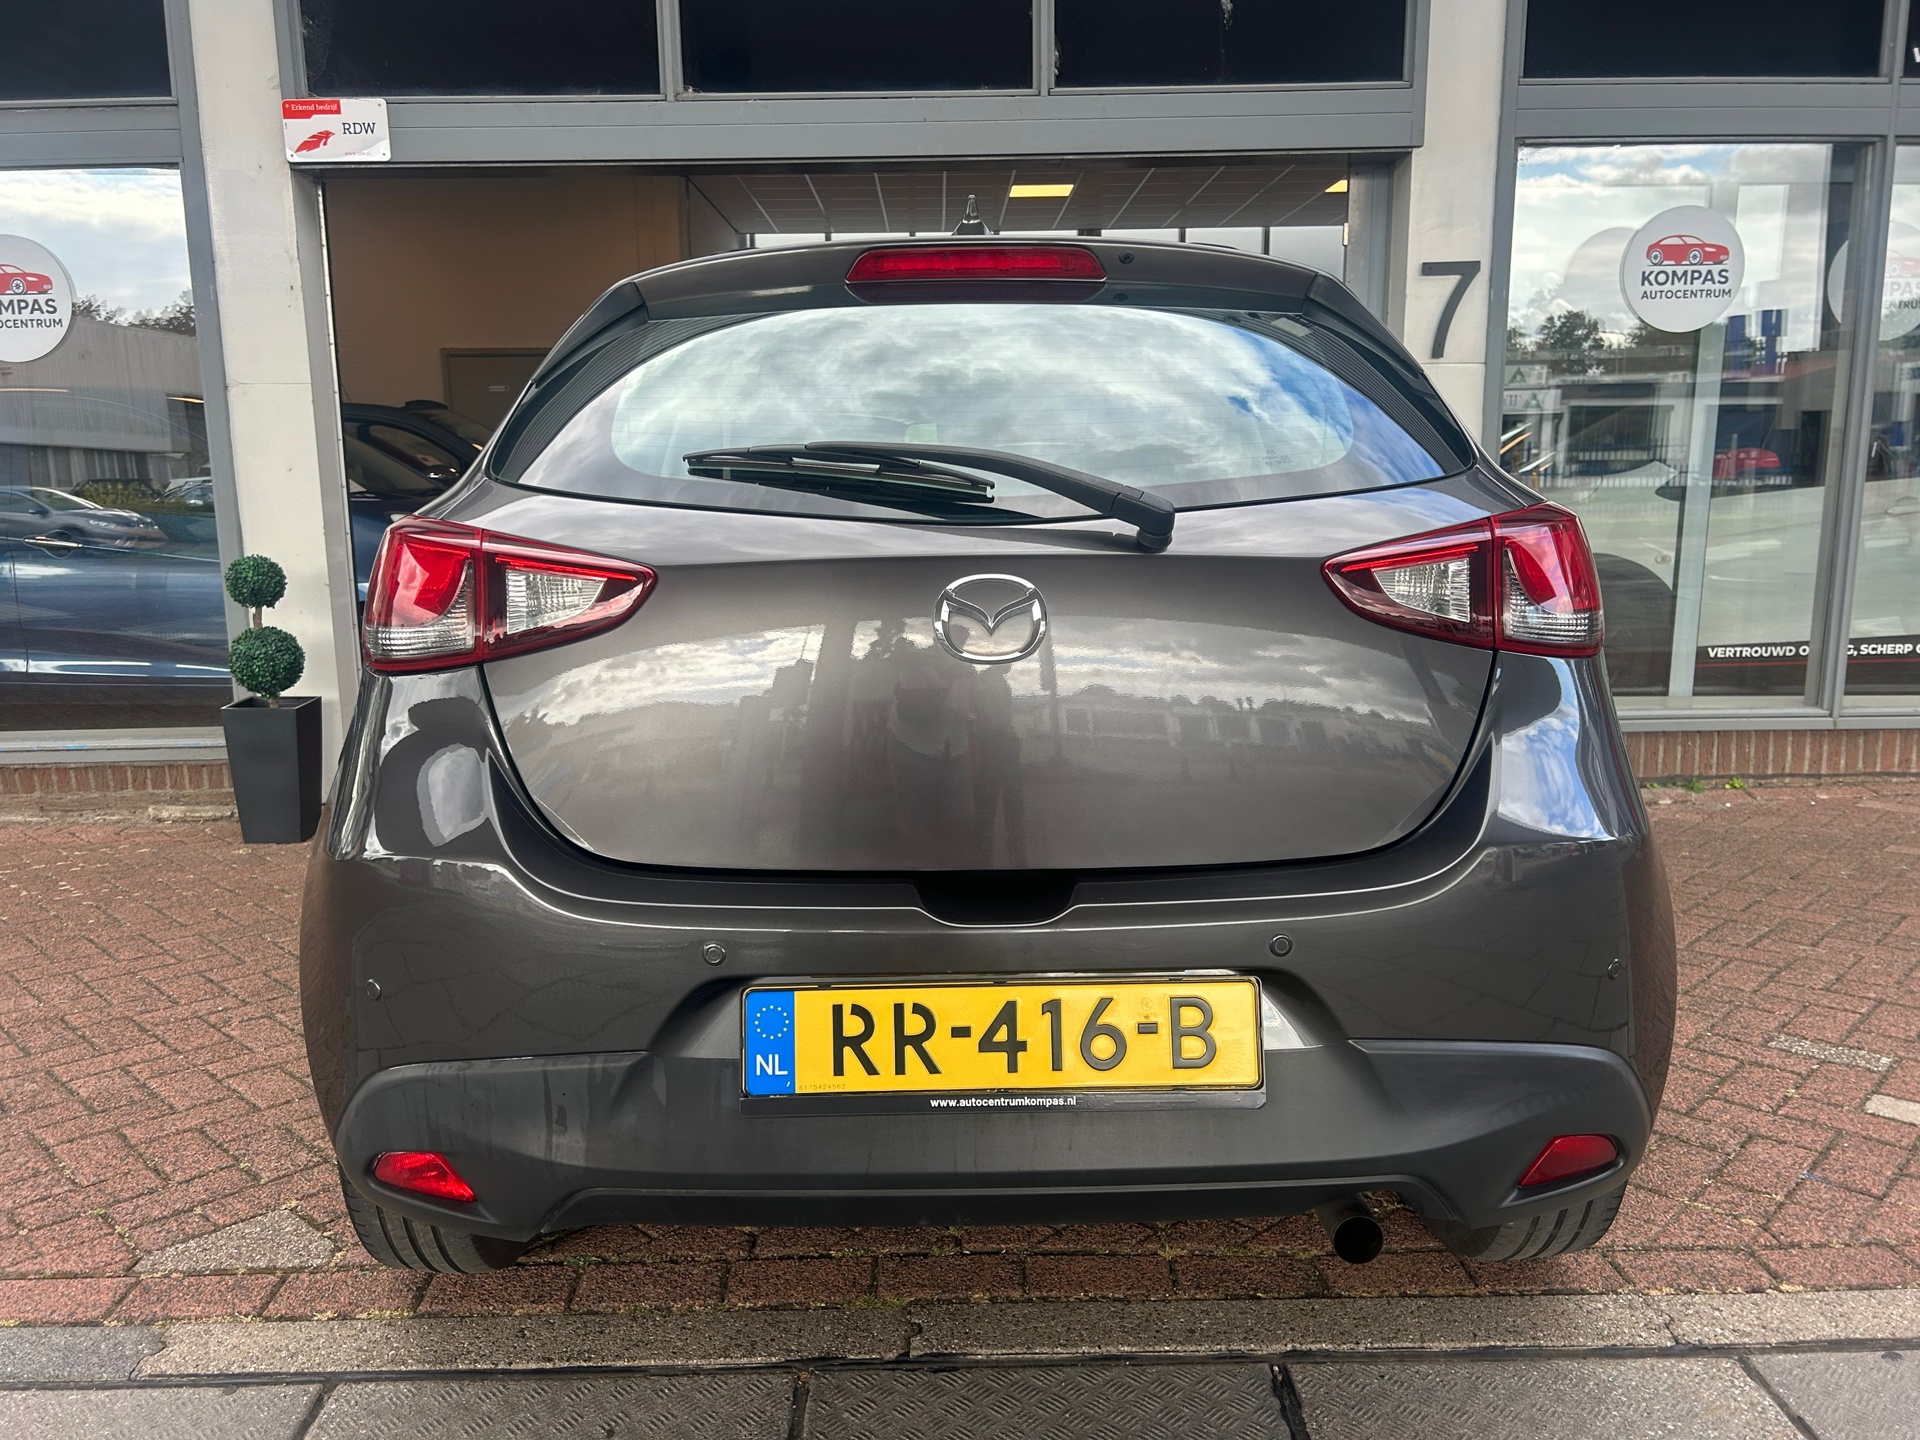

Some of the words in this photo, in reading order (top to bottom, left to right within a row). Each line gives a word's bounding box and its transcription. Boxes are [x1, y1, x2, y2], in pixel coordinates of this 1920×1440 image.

[316, 103, 338, 112] bedrijf
[342, 122, 376, 135] RDW
[1641, 268, 1730, 287] KOMPAS
[1641, 288, 1732, 300] AUTOCENTRUM
[0, 298, 58, 315] MPAS
[1421, 261, 1481, 359] 7
[0, 318, 63, 329] OCENTRUM
[1708, 646, 1796, 658] VERTROUWD
[1860, 643, 1914, 655] SCHERP
[832, 996, 1217, 1076] RR-416-B
[756, 1053, 788, 1076] NL
[930, 1096, 1076, 1108] www.autocentrumkompas.nl
